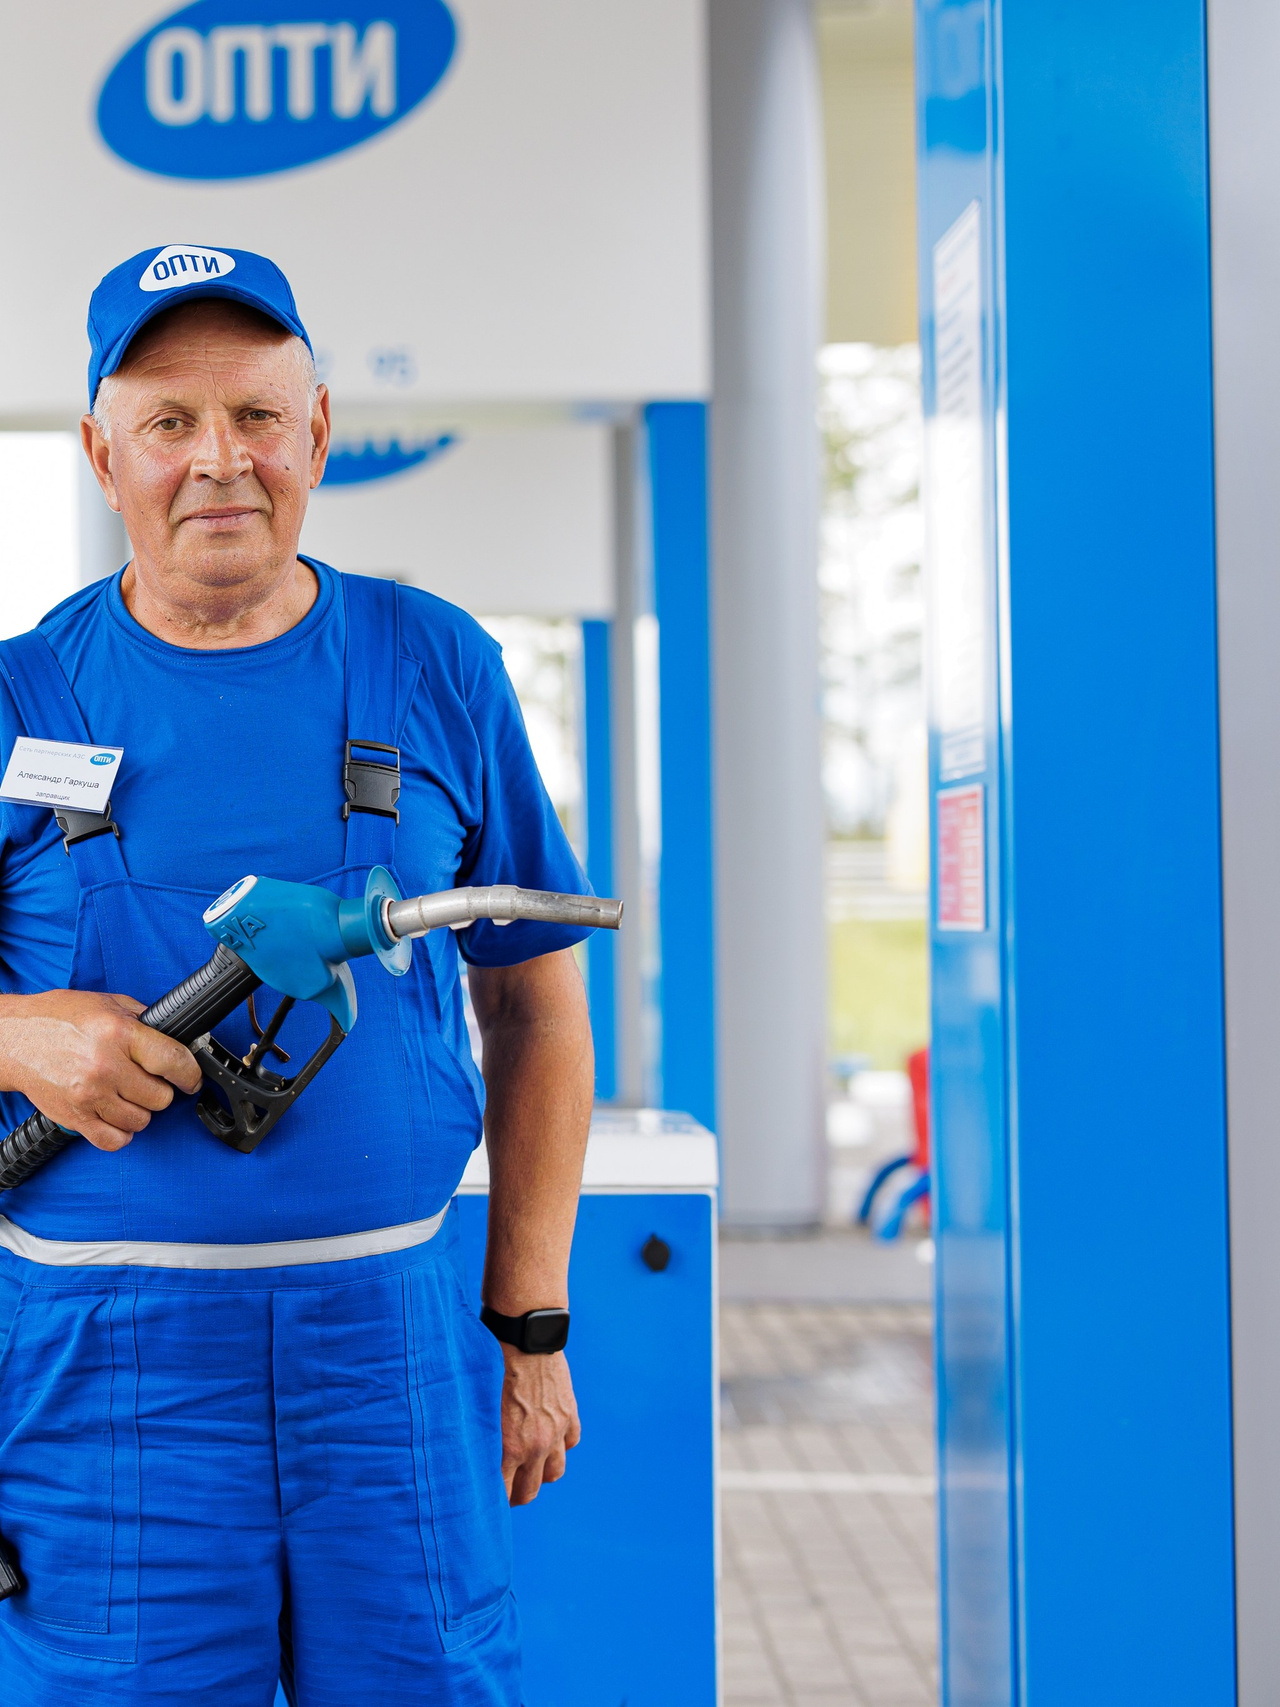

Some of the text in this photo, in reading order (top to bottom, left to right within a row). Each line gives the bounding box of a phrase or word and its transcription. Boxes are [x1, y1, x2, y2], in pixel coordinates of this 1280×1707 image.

[146, 20, 397, 127] ОПТИ
[153, 254, 221, 281] ОПТИ
[72, 752, 85, 760] АЗС
[93, 755, 112, 764] ОПТИ
[17, 770, 100, 789] Александр Гаркуша
[35, 791, 70, 801] заправщик
